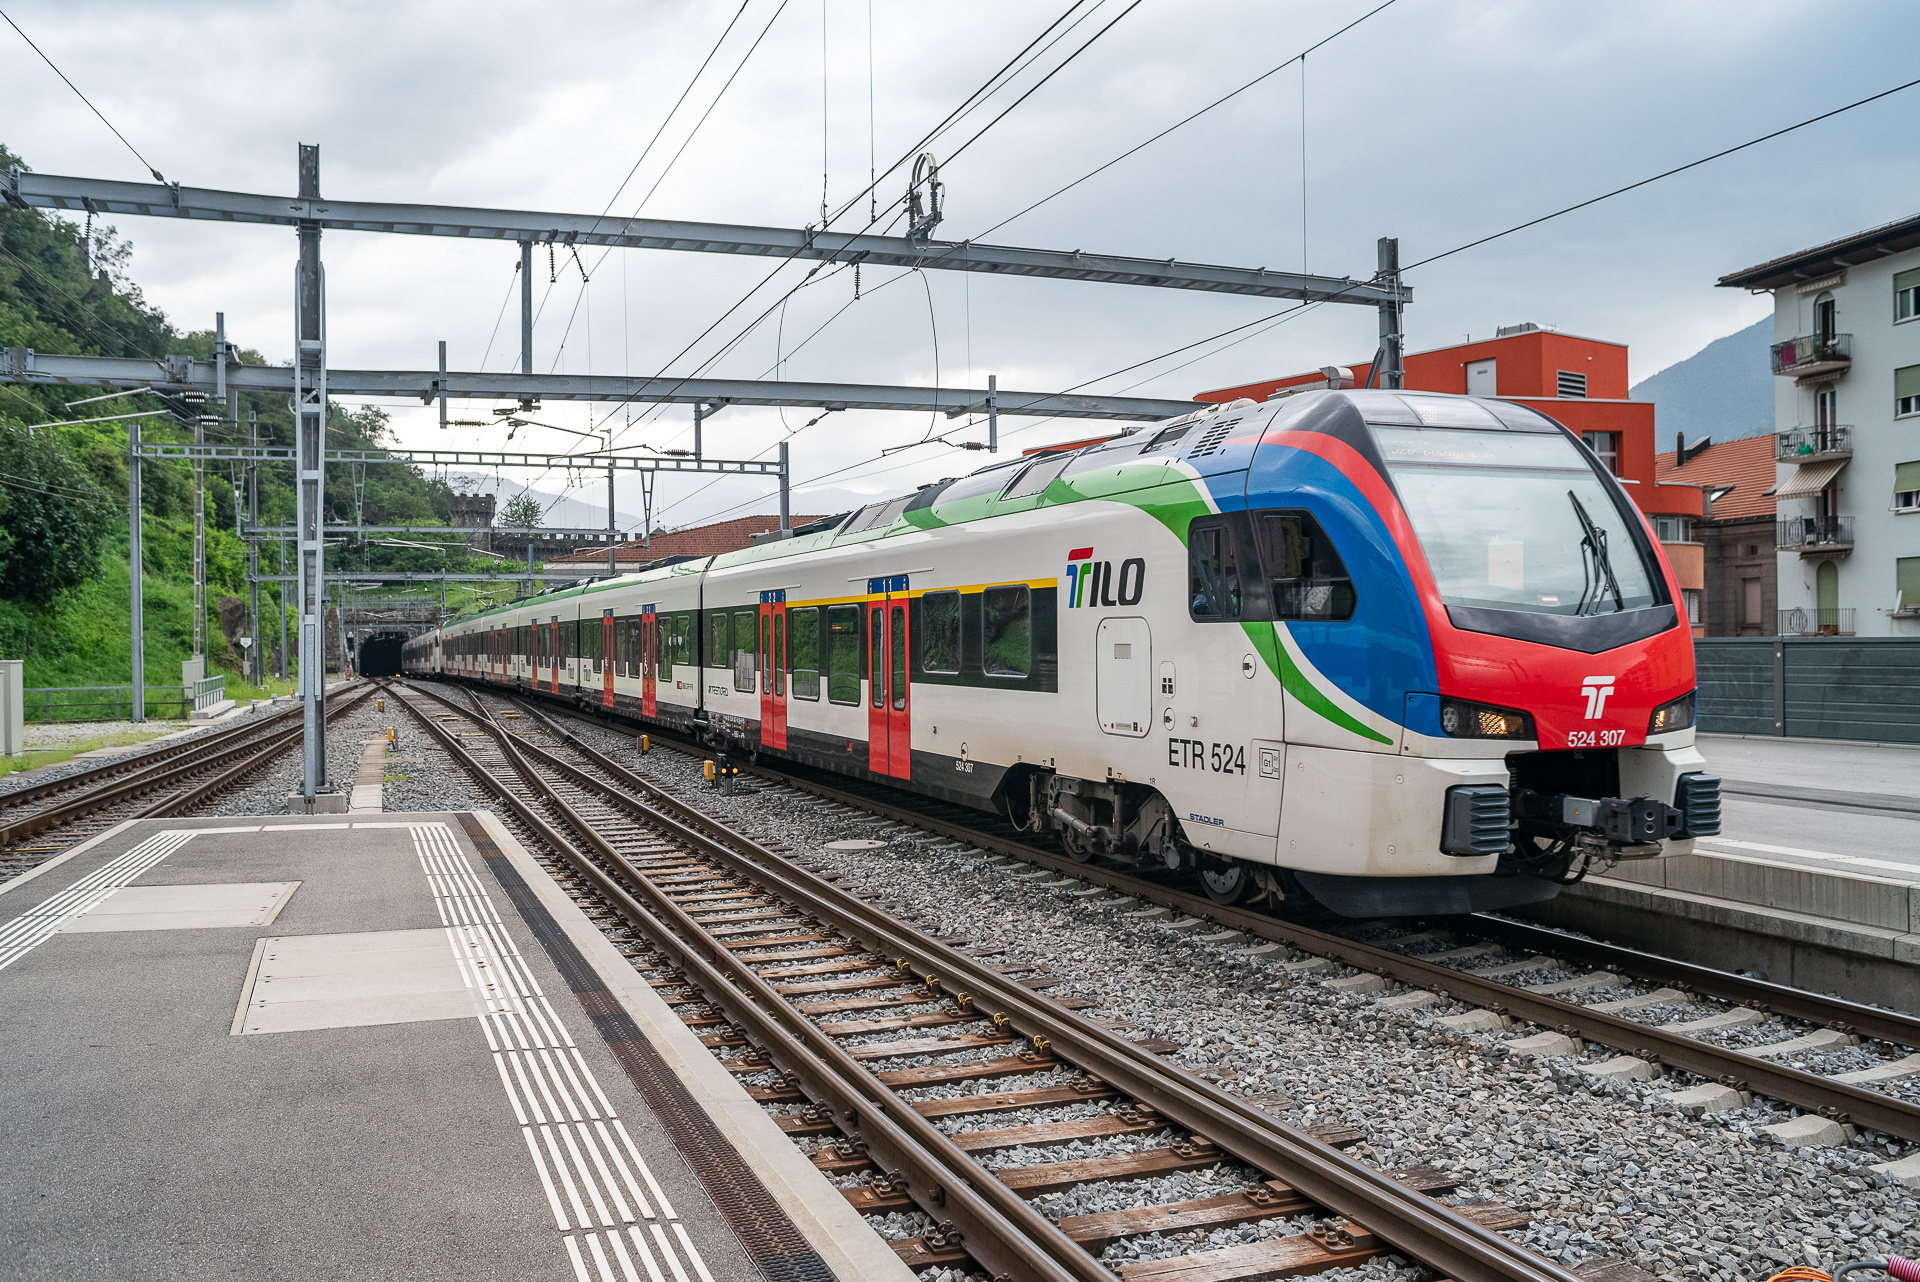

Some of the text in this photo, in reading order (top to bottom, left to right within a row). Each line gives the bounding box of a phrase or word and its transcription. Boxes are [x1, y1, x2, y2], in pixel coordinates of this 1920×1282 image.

[882, 578, 892, 593] 1 1
[1066, 547, 1145, 608] TILO
[1567, 729, 1626, 747] 524 307
[1168, 737, 1246, 775] ETR 524
[955, 760, 974, 773] 524 307
[1189, 813, 1225, 827] STADLER
